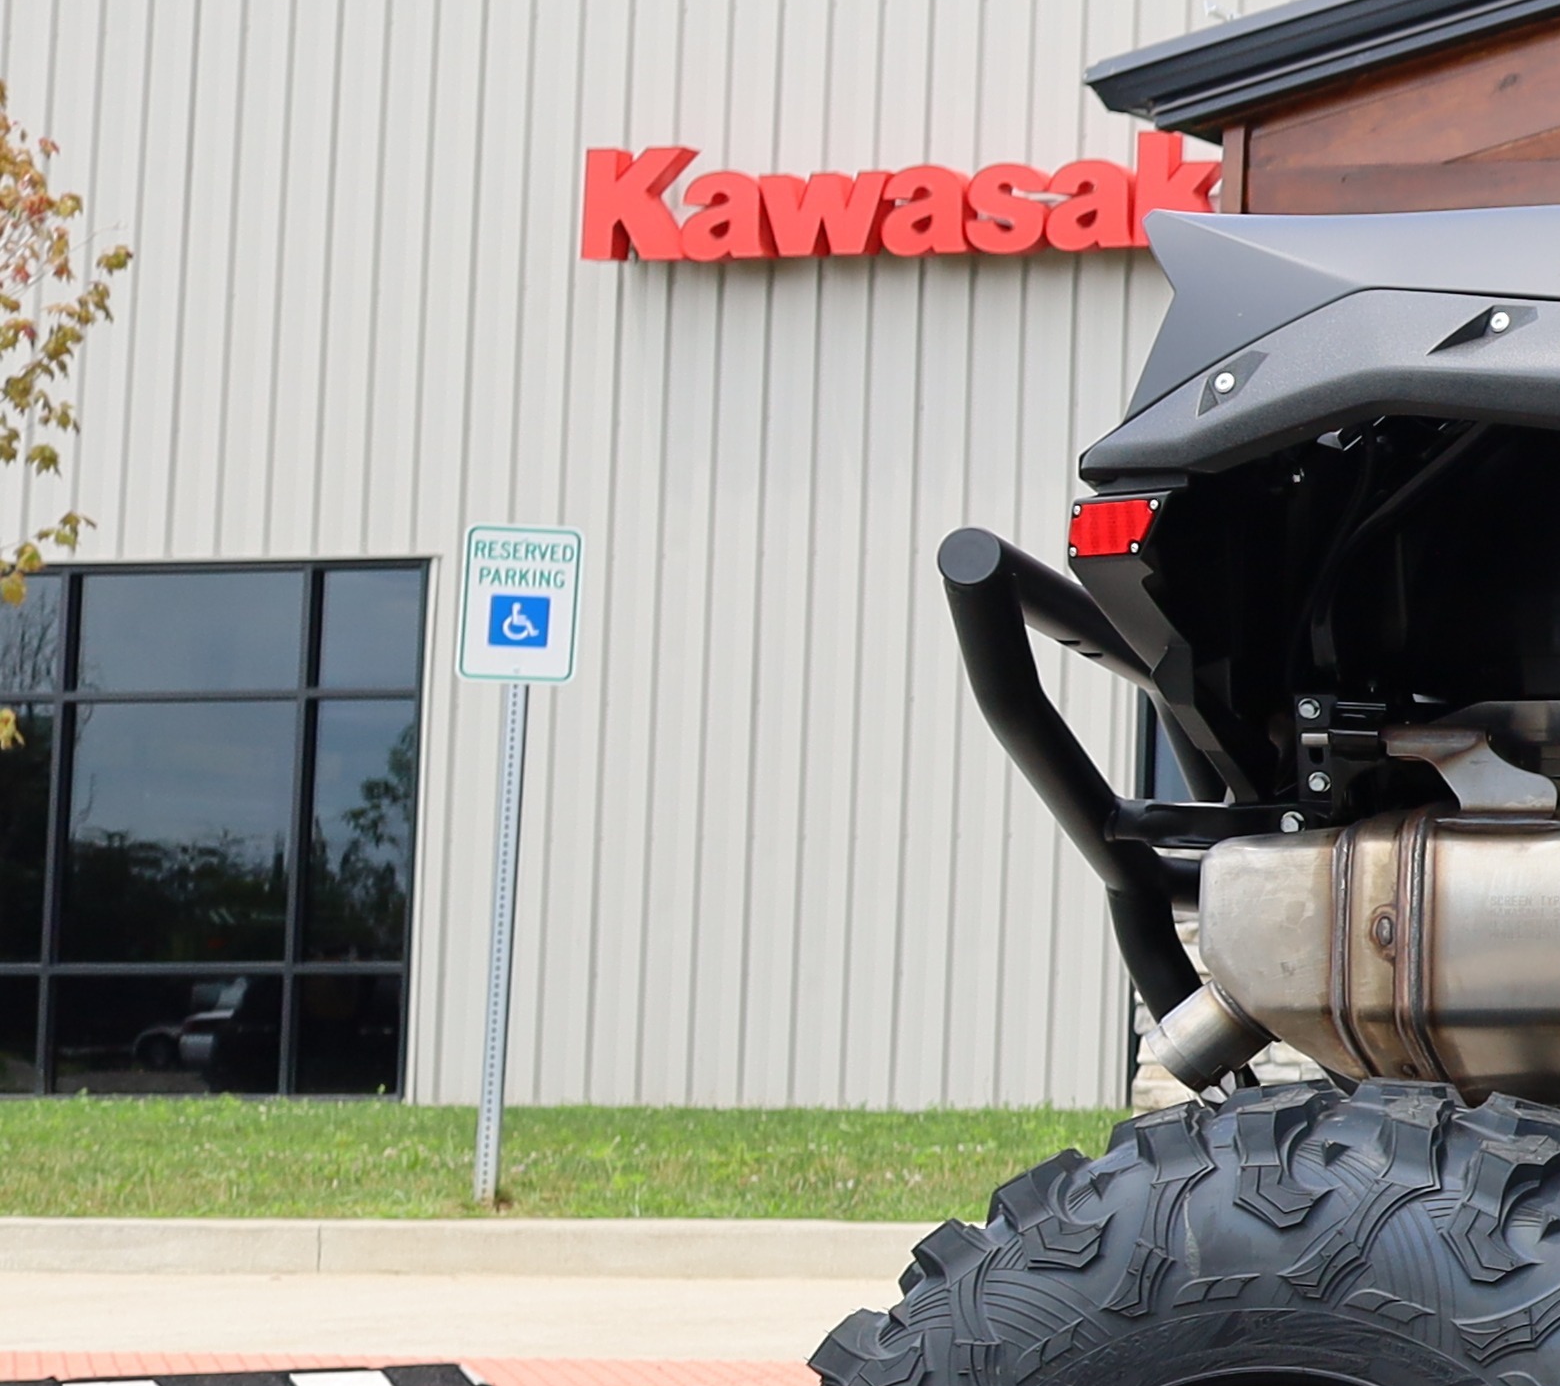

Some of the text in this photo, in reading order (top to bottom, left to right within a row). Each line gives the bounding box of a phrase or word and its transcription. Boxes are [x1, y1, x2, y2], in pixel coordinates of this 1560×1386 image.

[581, 130, 1224, 262] Kawasak
[474, 540, 575, 562] RESERVED
[478, 566, 566, 589] PARKING
